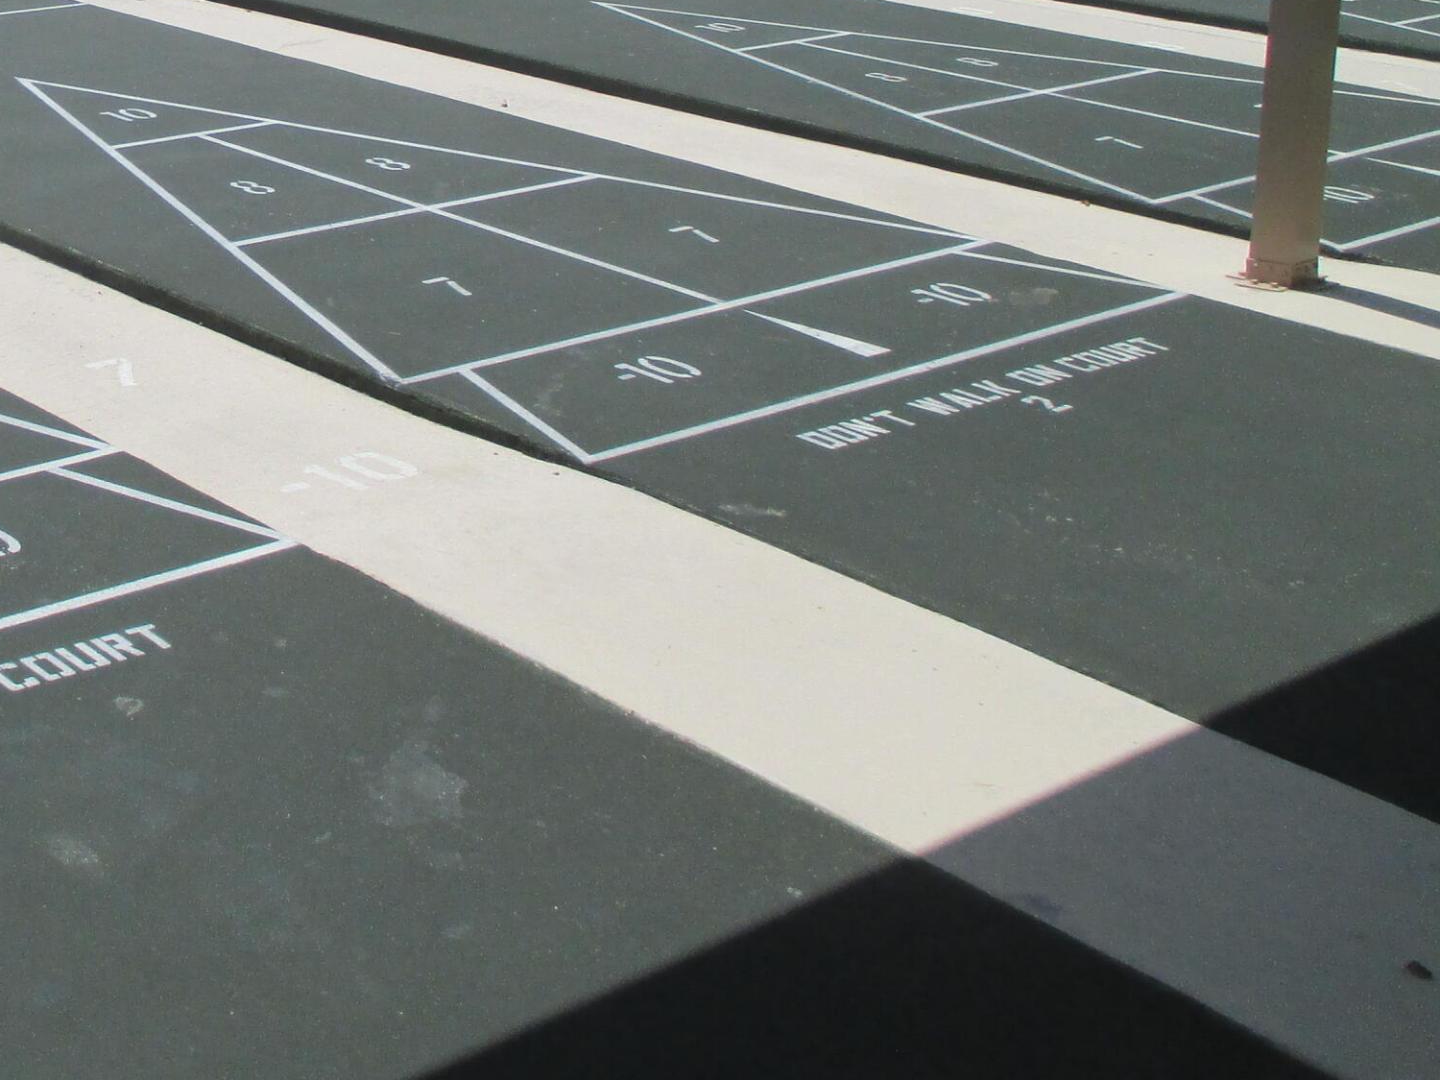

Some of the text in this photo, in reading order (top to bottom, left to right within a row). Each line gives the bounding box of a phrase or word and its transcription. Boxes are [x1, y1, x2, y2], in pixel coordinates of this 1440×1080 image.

[100, 108, 157, 122] 10
[365, 157, 411, 171] 8
[229, 180, 276, 195] 8
[1322, 185, 1375, 204] 10
[668, 225, 720, 243] 7
[421, 276, 473, 296] 7
[910, 281, 993, 307] -10
[84, 357, 138, 387] 7
[613, 354, 703, 385] -10
[796, 336, 1170, 450] DON'T WALK ON COURT
[1019, 394, 1074, 413] 2
